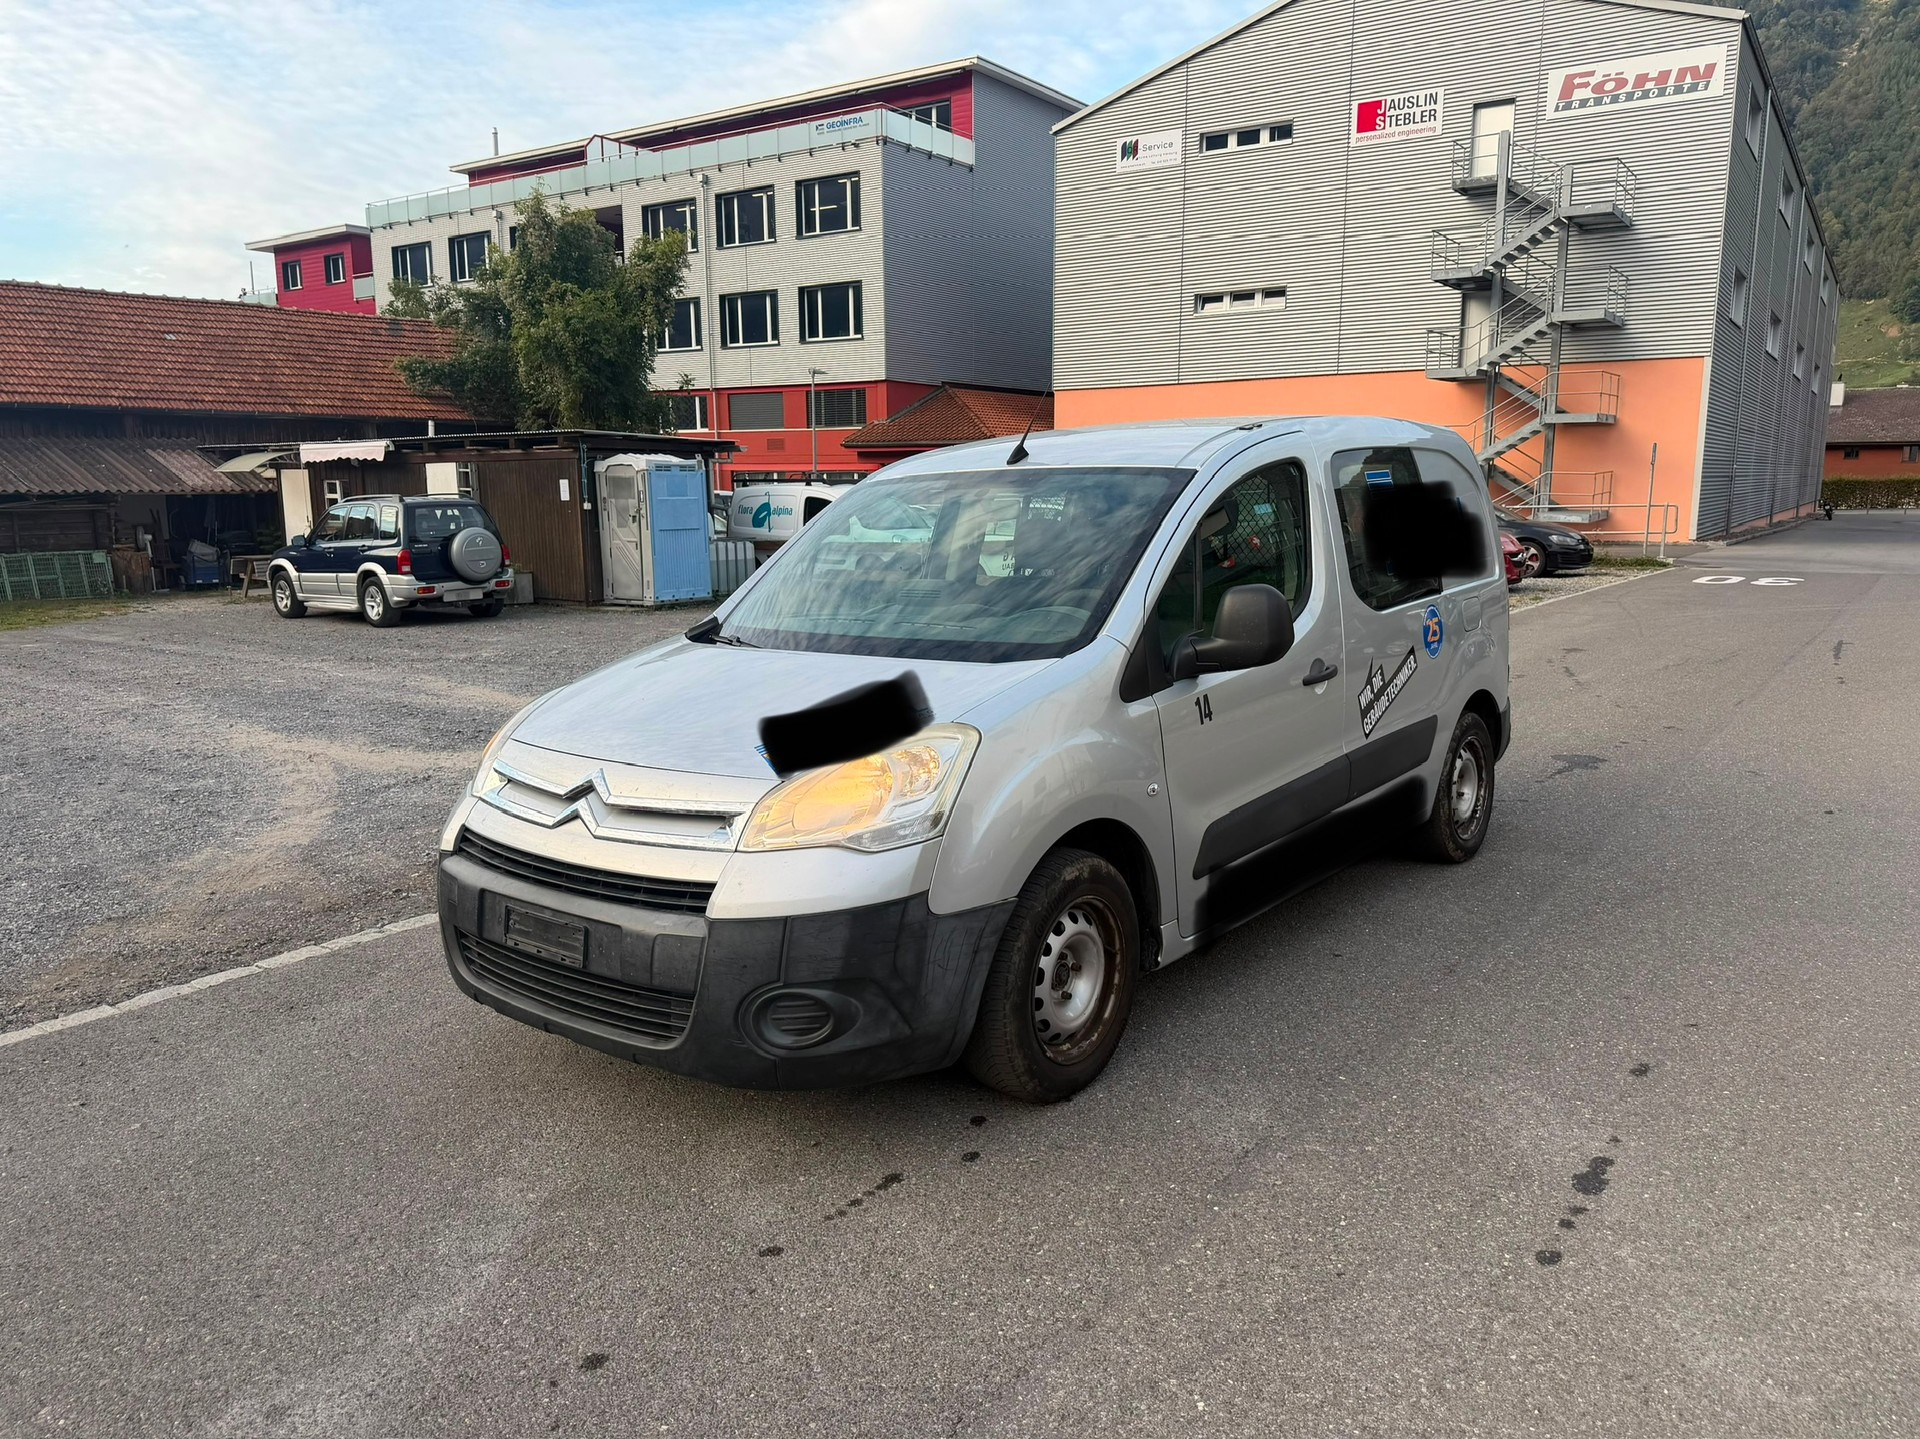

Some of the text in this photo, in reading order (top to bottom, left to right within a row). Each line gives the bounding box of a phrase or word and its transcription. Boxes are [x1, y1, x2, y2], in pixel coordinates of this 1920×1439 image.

[1377, 91, 1438, 114] JAUSLIN
[1557, 81, 1707, 111] TRANSPORTE
[826, 116, 864, 130] GEOINFRA
[1375, 108, 1437, 130] STEBLER
[1355, 126, 1437, 144] personalized engineering
[738, 504, 793, 517] flora alpina
[1426, 617, 1440, 643] 25
[1371, 669, 1384, 694] DIE
[1194, 693, 1213, 725] 14
